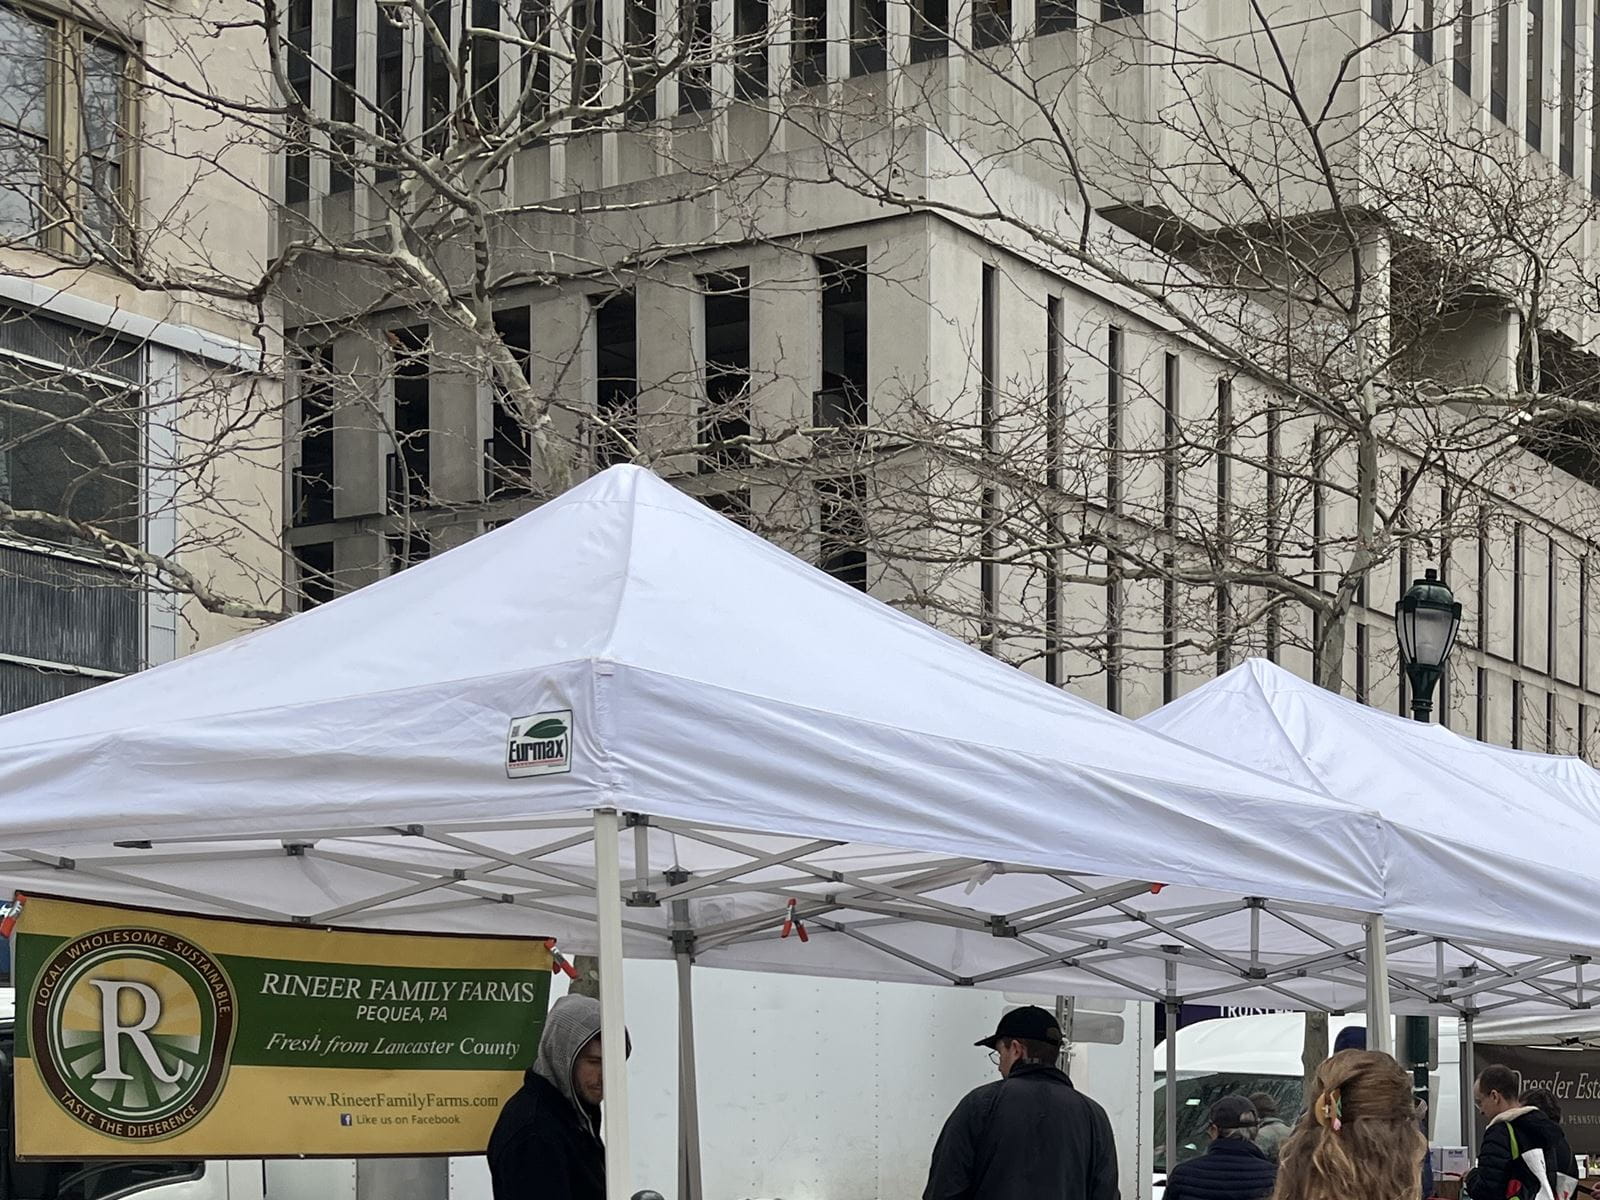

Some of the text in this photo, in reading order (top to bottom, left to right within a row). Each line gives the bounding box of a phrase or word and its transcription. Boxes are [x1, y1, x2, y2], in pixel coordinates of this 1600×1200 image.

[509, 739, 564, 763] Eurmax
[36, 931, 232, 1018] LOCAL. WHOLESOME. SUSTAINABLE.
[260, 972, 535, 1003] RINEER FAMILY FARMS
[356, 1005, 448, 1023] PEQUEA, PA
[89, 978, 185, 1084] R
[266, 1032, 520, 1060] Fresh from Lancaster County
[61, 1091, 198, 1137] TASTE THE DIFFERENCE
[289, 1092, 499, 1111] www.RineerFamilyFarms.com
[356, 1115, 378, 1125] Like
[381, 1116, 393, 1125] us
[395, 1116, 409, 1125] on
[411, 1115, 461, 1125] Facebook
